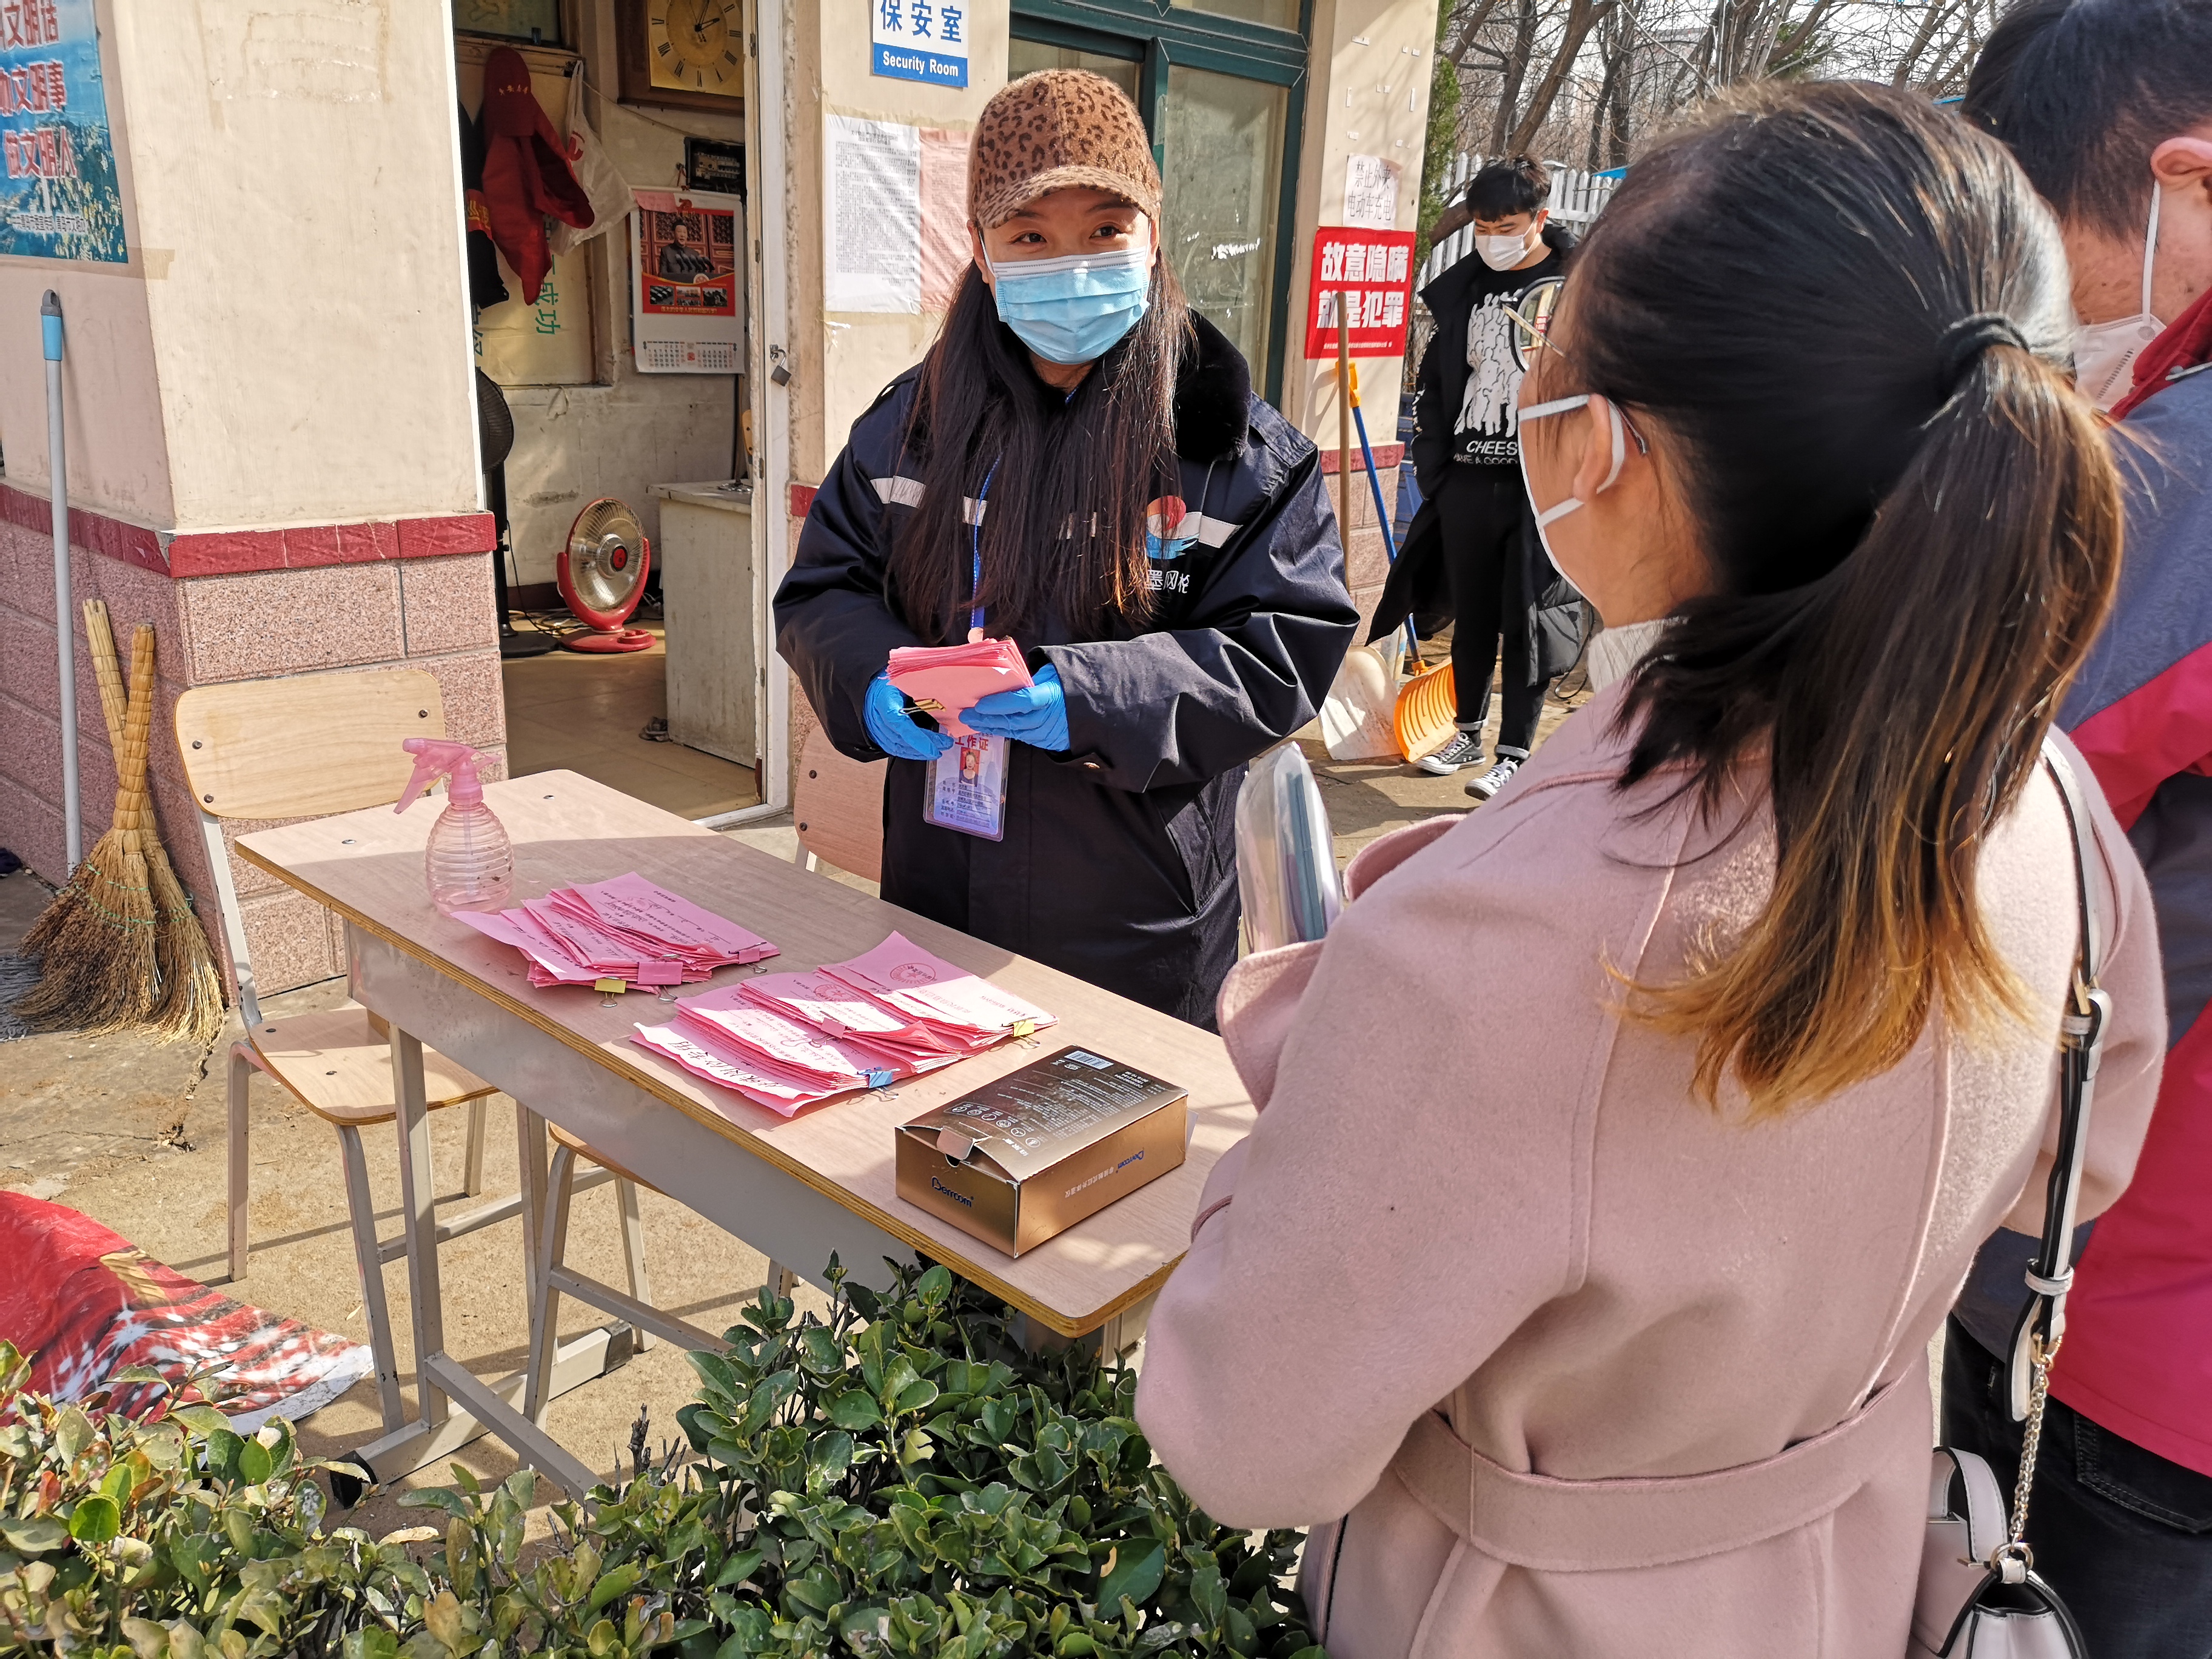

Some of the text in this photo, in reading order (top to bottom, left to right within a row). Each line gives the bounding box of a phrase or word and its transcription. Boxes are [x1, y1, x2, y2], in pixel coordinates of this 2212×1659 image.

[0, 0, 60, 50] 文明话
[880, 0, 962, 42] 保安室
[883, 51, 959, 76] Security Room
[1354, 161, 1390, 190] 禁止外来
[1348, 191, 1391, 221] 电动车充电
[1321, 241, 1409, 283] 故意隐瞒
[1316, 289, 1405, 329] 就是犯罪
[1466, 440, 1518, 455] CHEES
[954, 735, 989, 751] 工作证
[931, 1176, 972, 1208] Berrcom
